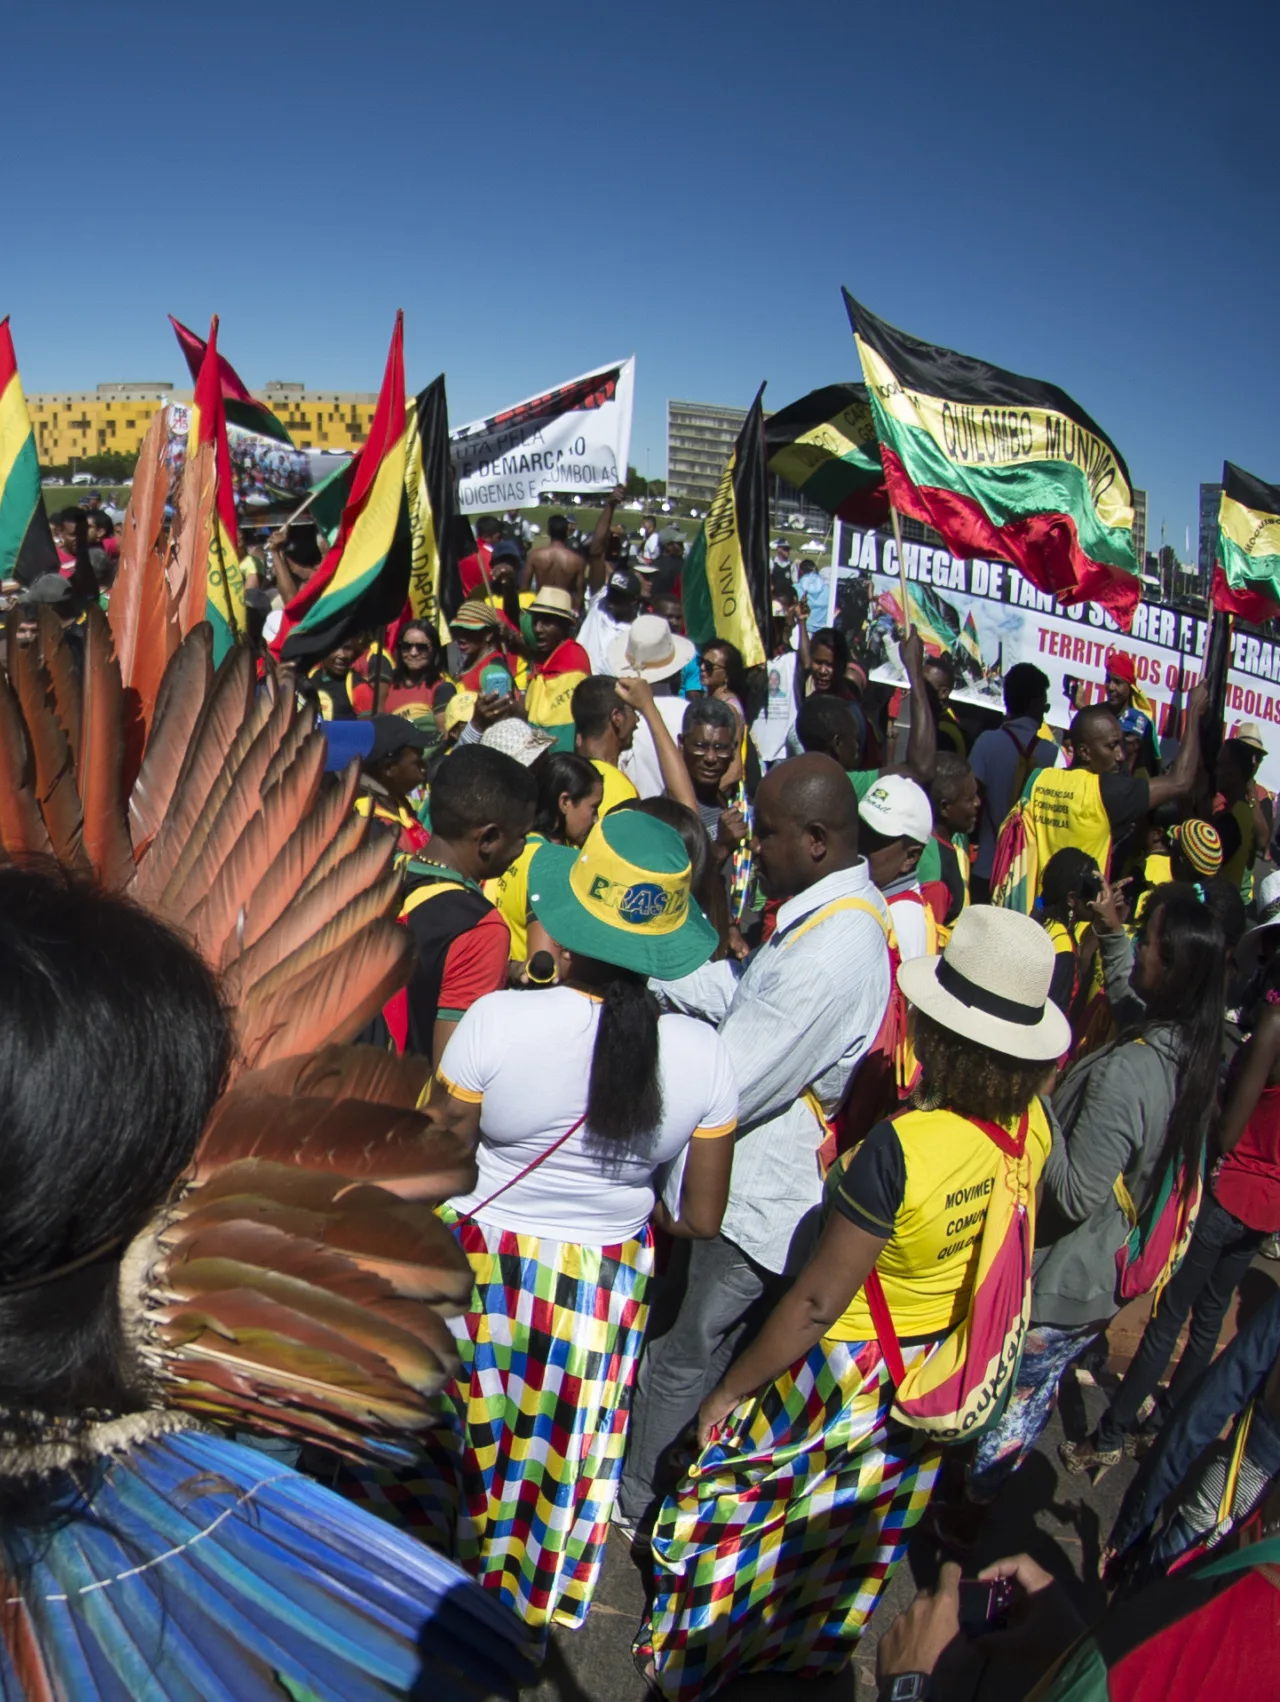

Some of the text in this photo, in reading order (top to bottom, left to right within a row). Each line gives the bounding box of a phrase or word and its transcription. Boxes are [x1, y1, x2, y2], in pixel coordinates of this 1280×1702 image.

[478, 436, 586, 479] DEMARCAO
[496, 425, 545, 450] PELA
[942, 402, 1033, 464] QUILOMBO
[719, 554, 737, 617] VIVO
[848, 530, 877, 571] JÁ
[882, 539, 966, 592] CHEGA
[971, 558, 1003, 600] DE
[588, 873, 688, 916] BRASIL
